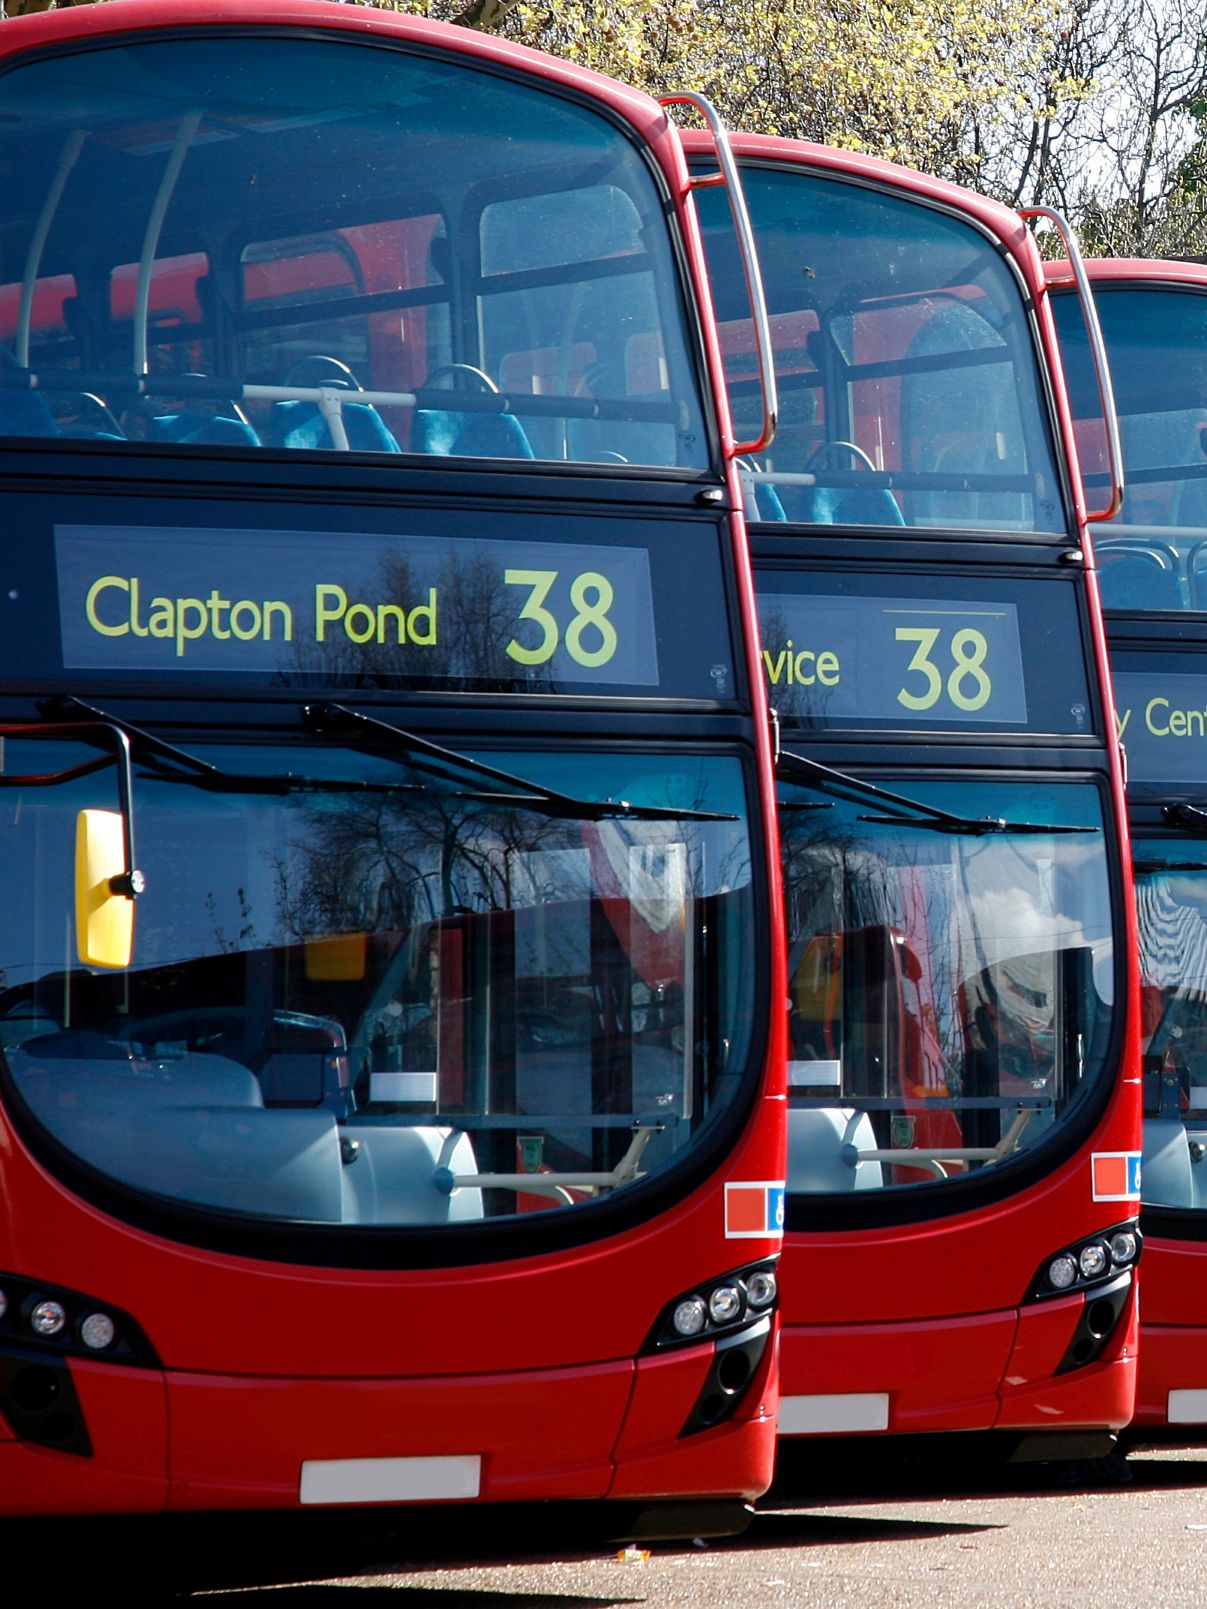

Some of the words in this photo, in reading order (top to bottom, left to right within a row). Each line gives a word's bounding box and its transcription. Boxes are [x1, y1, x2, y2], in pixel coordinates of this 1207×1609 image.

[86, 576, 292, 657] Clapton
[316, 584, 438, 646] Pond
[504, 569, 617, 668] 38
[895, 628, 992, 711] 38
